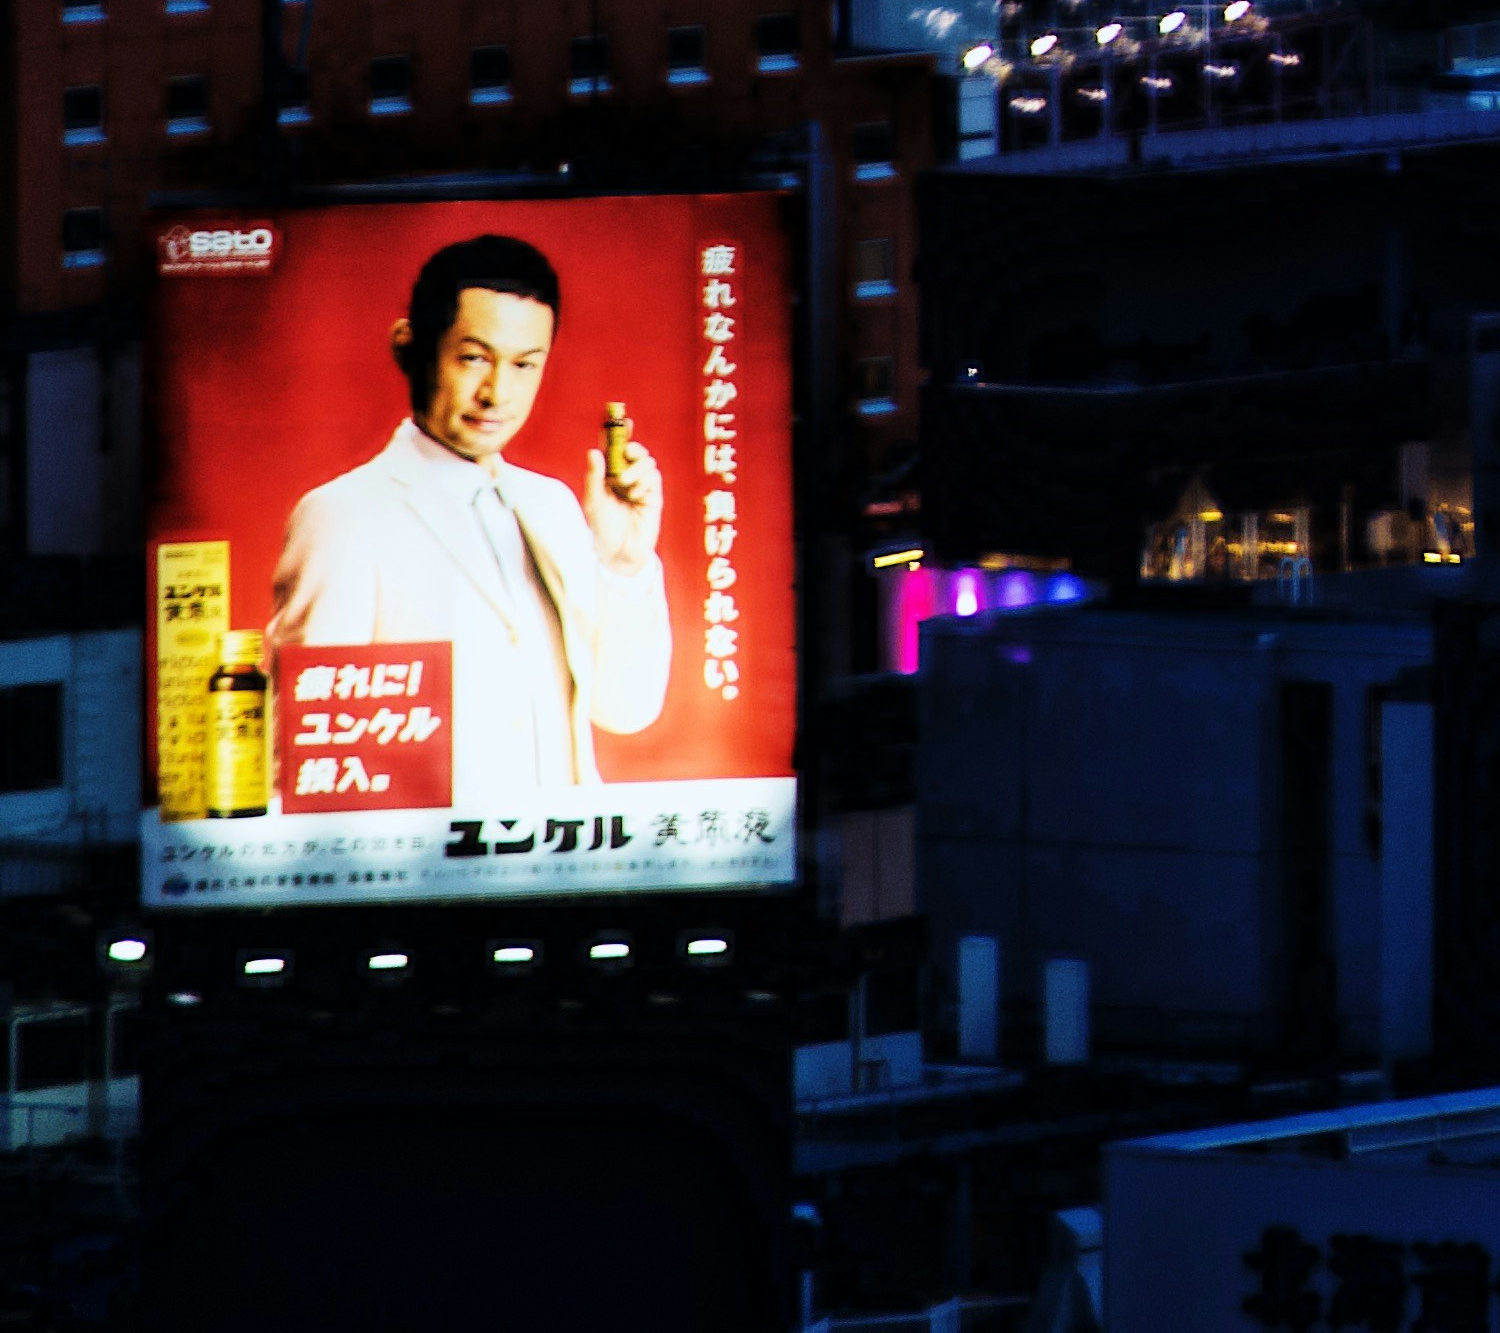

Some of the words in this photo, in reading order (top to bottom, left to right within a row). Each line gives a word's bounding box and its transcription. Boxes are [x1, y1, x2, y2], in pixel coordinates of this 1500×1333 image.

[190, 229, 272, 254] sato
[701, 245, 739, 701] 疲れなんかには、負けられない。
[294, 707, 441, 746] ユンケル
